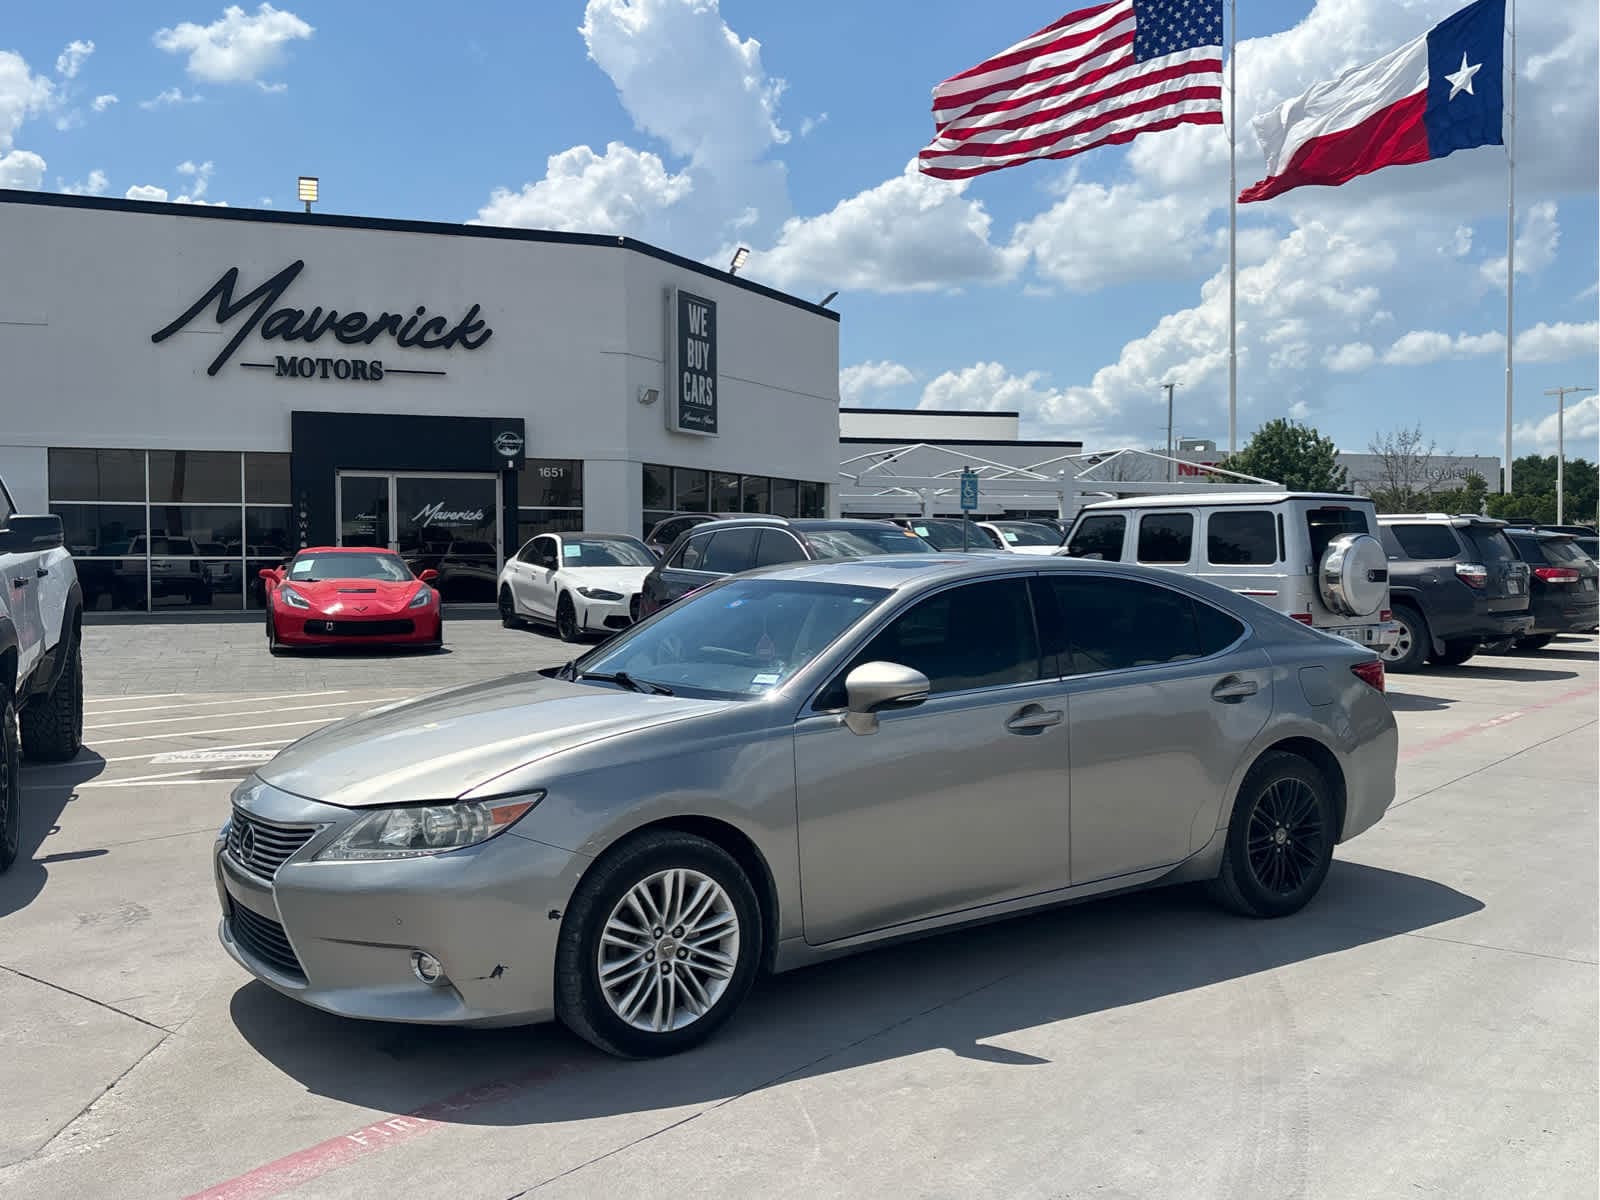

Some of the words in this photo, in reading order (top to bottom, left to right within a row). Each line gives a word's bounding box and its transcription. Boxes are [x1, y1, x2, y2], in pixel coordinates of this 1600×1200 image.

[151, 259, 493, 377] Maverick
[688, 303, 708, 337] WE
[274, 355, 384, 382] MOTORS
[687, 337, 710, 371] BUY
[683, 371, 713, 406] CARS
[539, 467, 564, 478] 1651
[412, 501, 484, 528] Maverick
